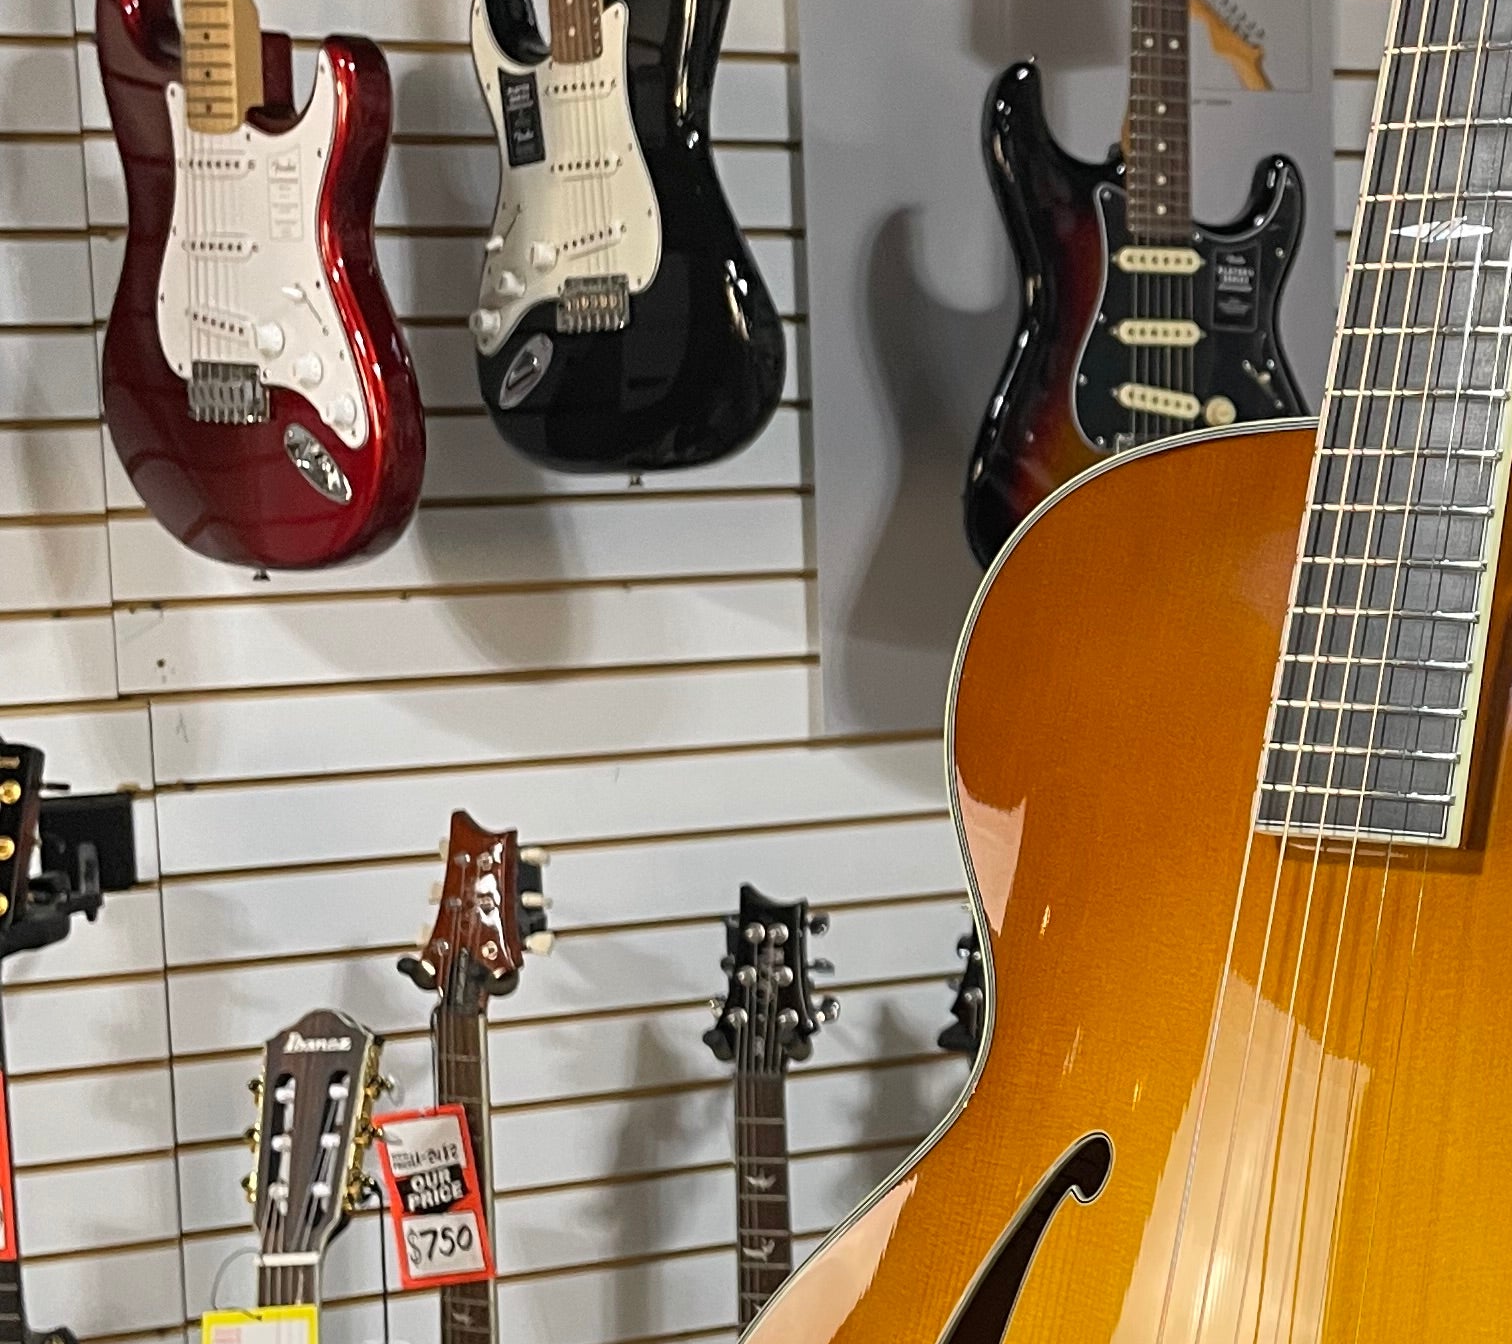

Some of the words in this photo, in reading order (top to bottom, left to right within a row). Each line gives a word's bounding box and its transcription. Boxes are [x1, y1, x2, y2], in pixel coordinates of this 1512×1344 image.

[283, 1031, 352, 1054] Ibanez
[410, 1167, 451, 1193] OUR
[406, 1179, 464, 1212] PRICE
[407, 1224, 473, 1268] $750
